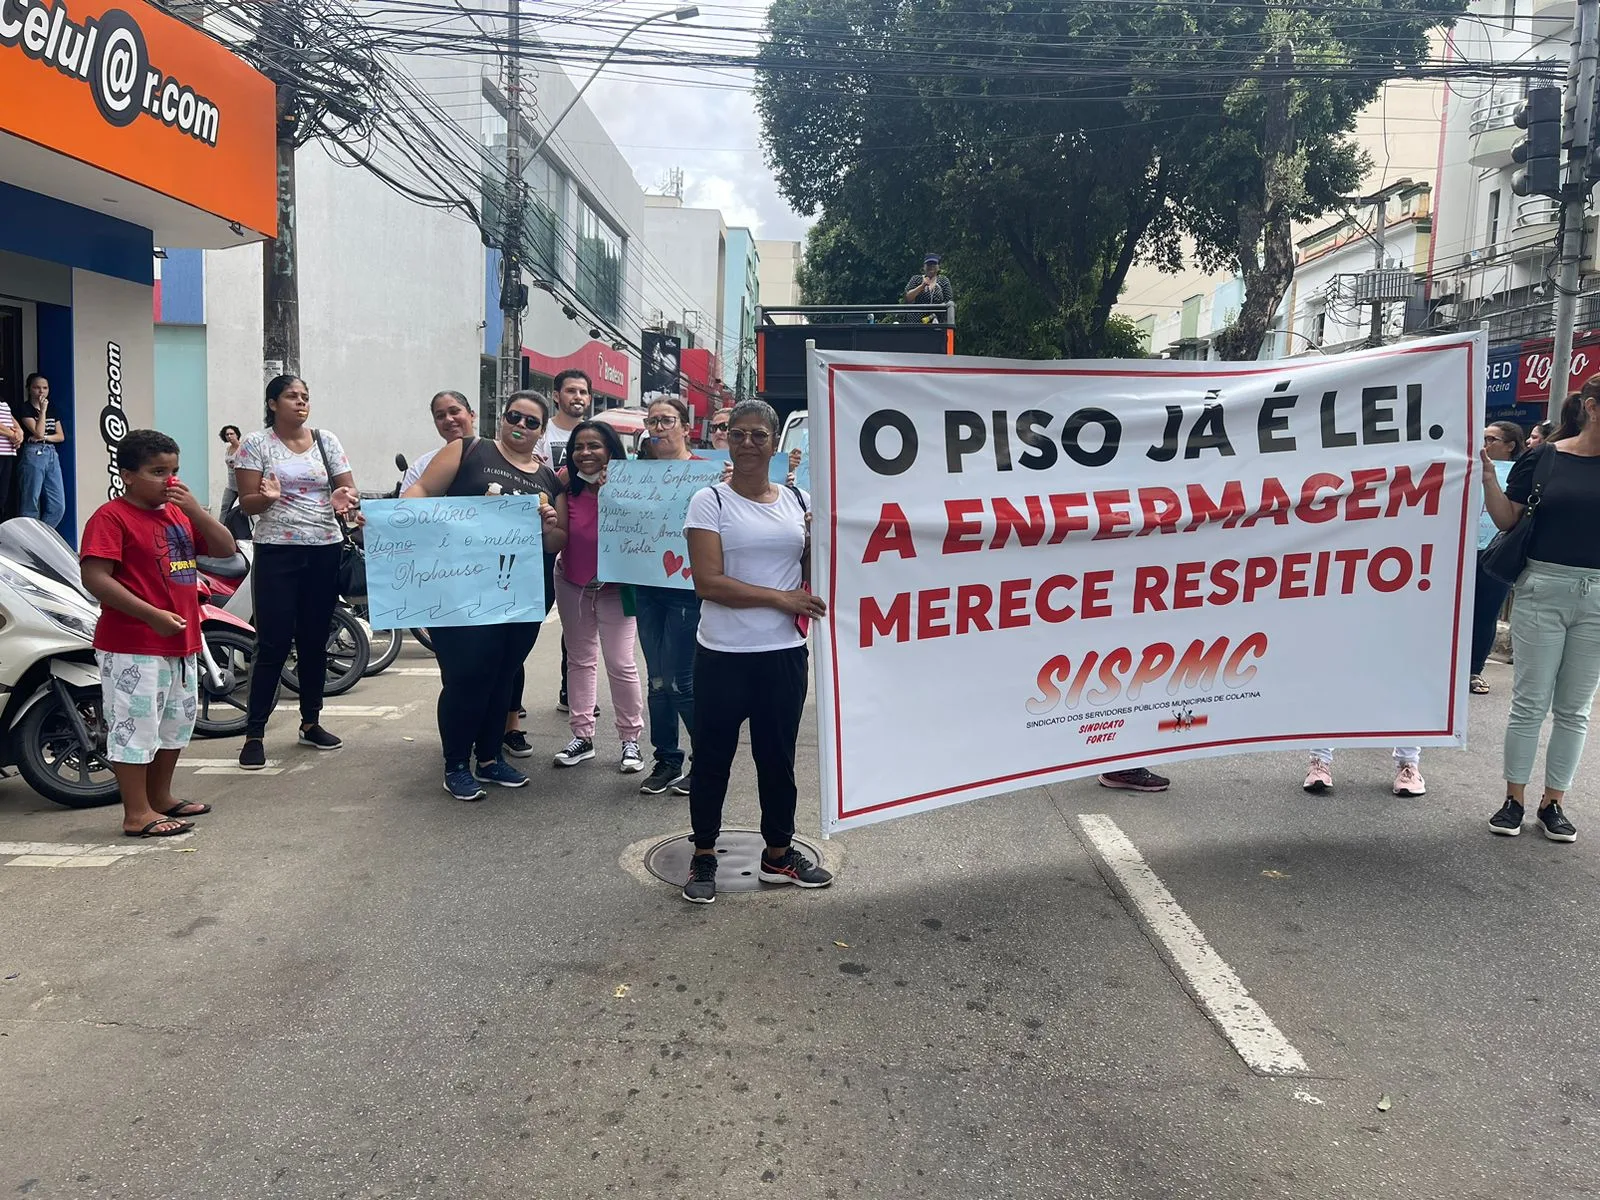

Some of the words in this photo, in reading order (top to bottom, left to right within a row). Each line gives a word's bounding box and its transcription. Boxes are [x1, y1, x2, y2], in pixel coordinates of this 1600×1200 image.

[0, 0, 220, 143] Celul@r.com
[1525, 349, 1590, 390] Lojo
[1486, 382, 1510, 394] nceira
[858, 409, 919, 476] O
[944, 407, 1122, 474] PISO
[1146, 389, 1236, 463] JÁ
[1258, 380, 1299, 454] É
[1320, 383, 1445, 449] LEI.
[661, 463, 723, 488] Enfermage
[388, 501, 479, 528] Salário
[861, 502, 917, 563] A
[941, 462, 1447, 554] ENFERMAGEM
[368, 535, 416, 561] digno
[464, 536, 472, 546] o
[484, 529, 537, 546] melhor
[652, 523, 683, 542] Ama
[392, 559, 490, 590] Aplauso
[858, 570, 1114, 648] MERECE
[1133, 543, 1434, 614] RESPEITO!
[1025, 632, 1268, 715] SISPMC
[1026, 716, 1066, 729] SINDICATO
[1067, 713, 1083, 723] DOS
[1085, 706, 1133, 720] SERVIDORES
[1133, 700, 1170, 713] PÚBLICOS
[1171, 695, 1213, 708] MUNICIPAIS
[1213, 694, 1224, 703] DE
[1225, 691, 1261, 701] COLATINA
[1079, 719, 1125, 734] SINDICATO
[1086, 732, 1116, 745] FORTE!
